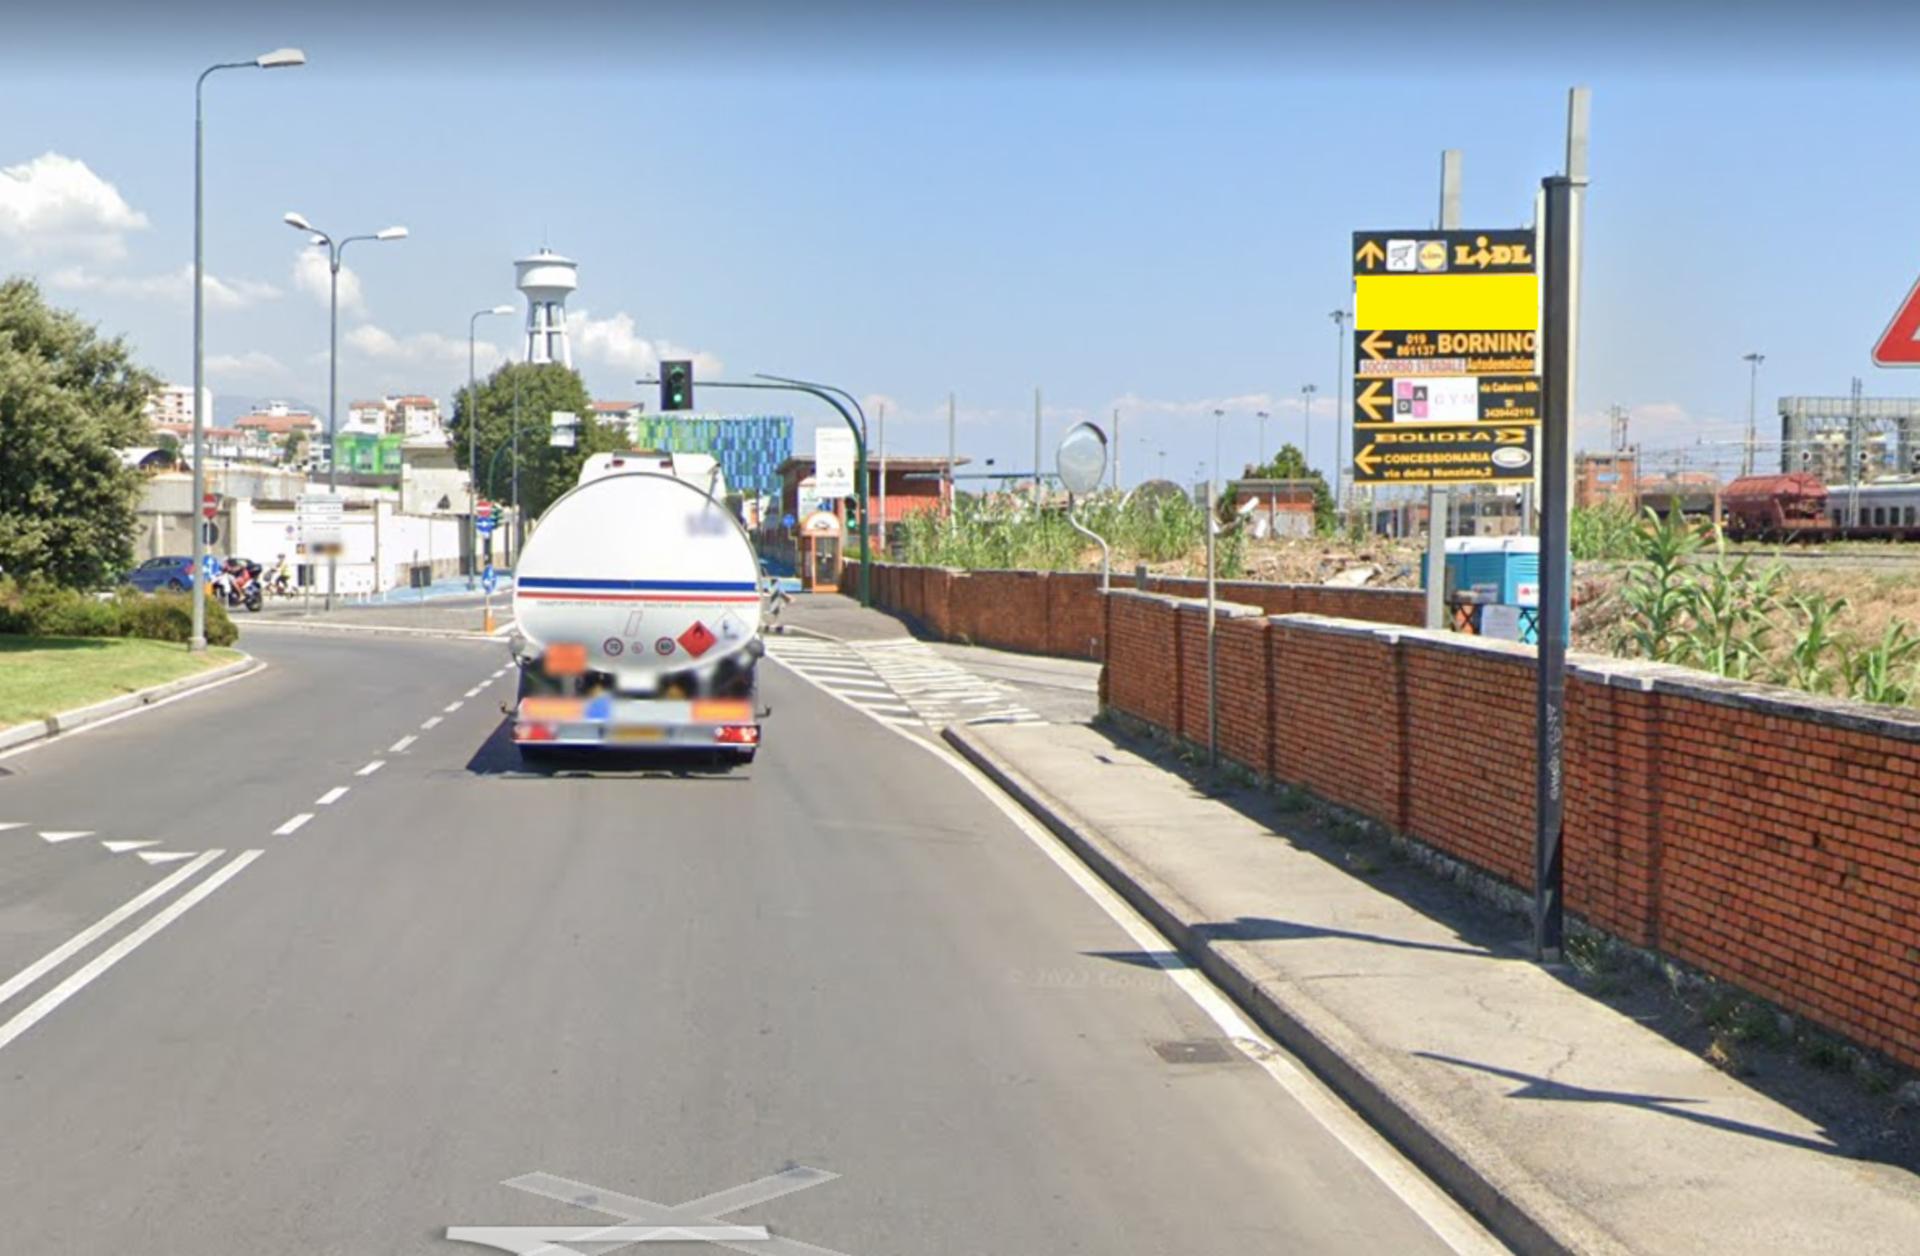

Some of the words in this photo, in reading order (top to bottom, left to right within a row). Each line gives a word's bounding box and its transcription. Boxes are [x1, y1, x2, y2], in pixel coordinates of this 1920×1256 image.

[1438, 332, 1537, 353] BORNINO
[1383, 451, 1490, 464] CONCESSIONARIA
[1384, 469, 1400, 478] via
[1403, 468, 1430, 478] della
